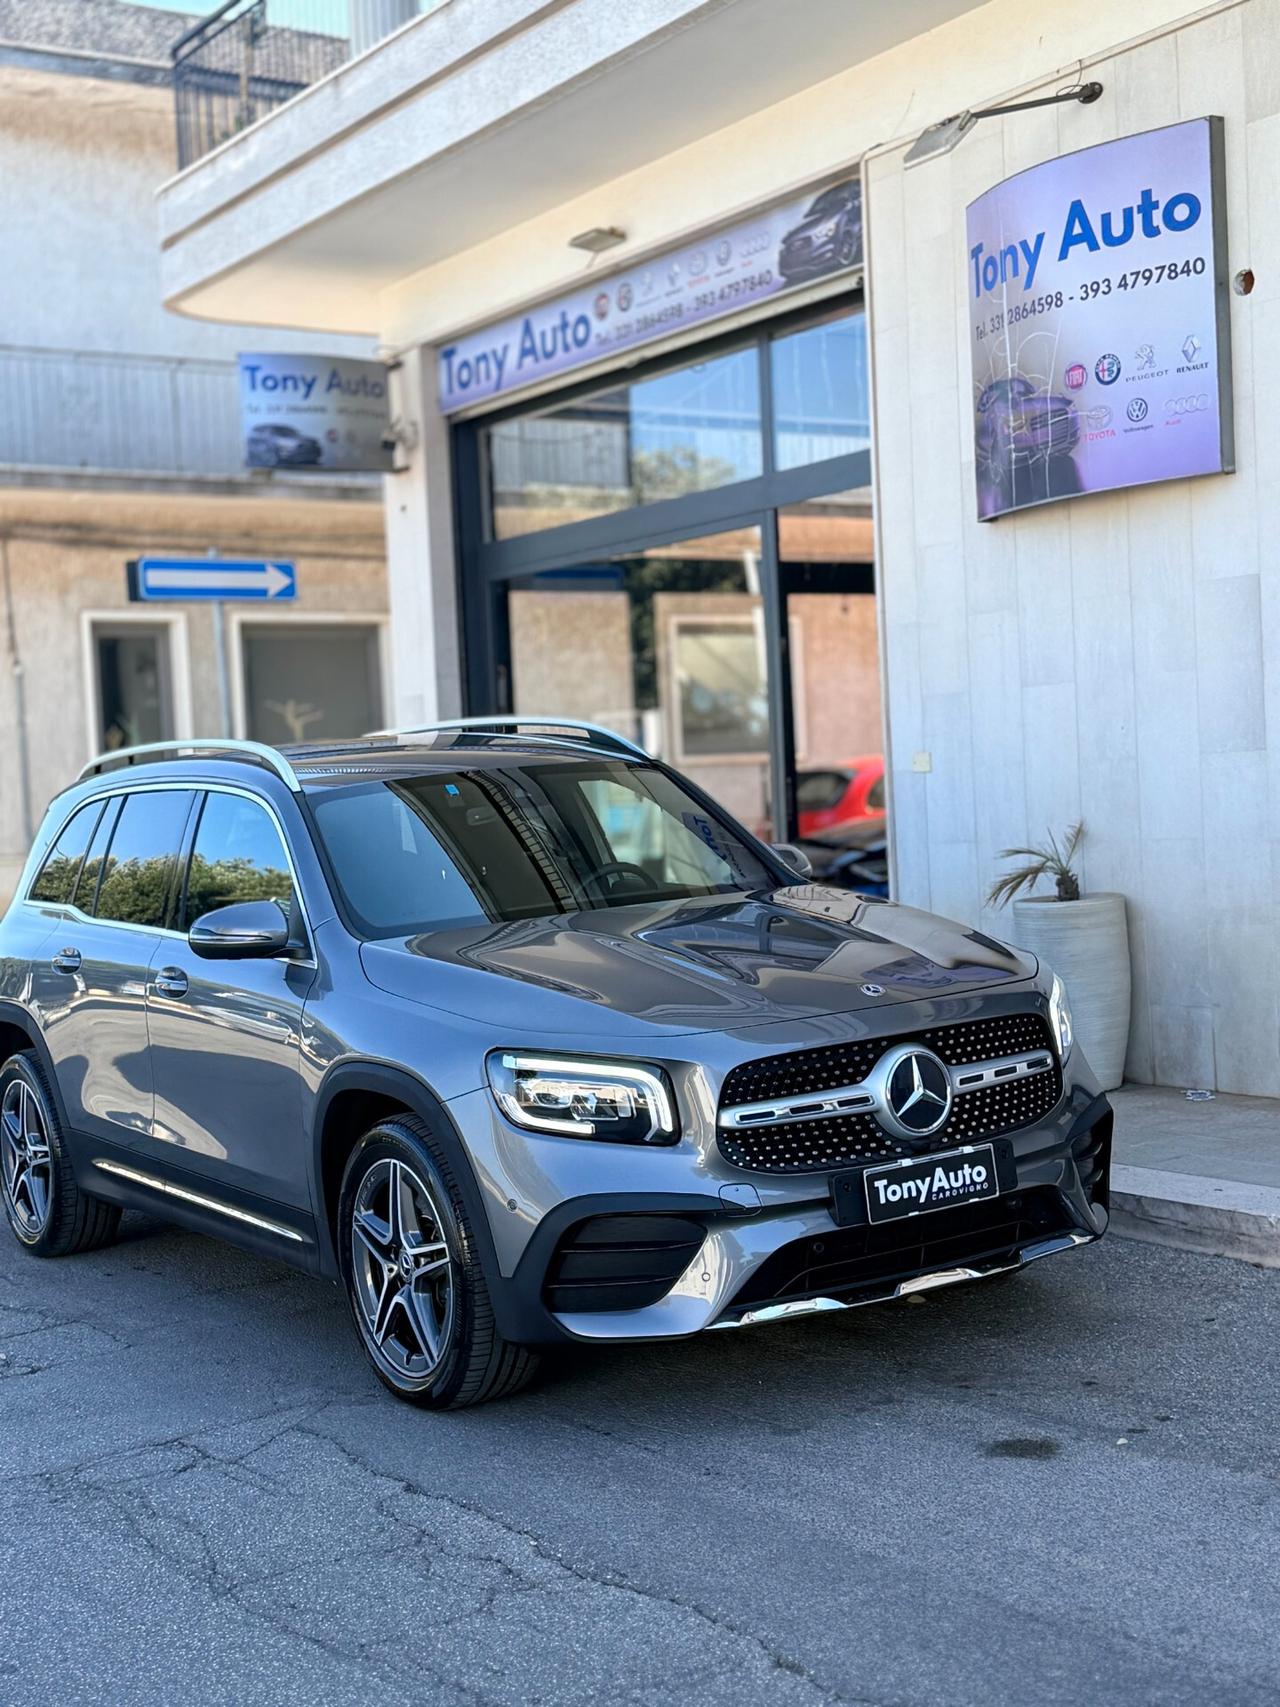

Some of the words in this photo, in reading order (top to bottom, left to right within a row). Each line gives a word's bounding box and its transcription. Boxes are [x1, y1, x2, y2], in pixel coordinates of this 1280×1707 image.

[971, 232, 1045, 298] Tony
[1057, 188, 1202, 262] Auto
[1007, 291, 1064, 326] 2864598
[1079, 278, 1112, 302] 393
[1117, 257, 1206, 291] 4797840
[442, 346, 508, 395] Tony
[517, 311, 591, 370] Auto
[1176, 362, 1209, 374] RENAULT
[243, 365, 317, 400] Tony
[325, 367, 386, 399] Auto
[1125, 369, 1169, 383] PEUGEOT
[931, 1182, 989, 1200] CAROVIGNO
